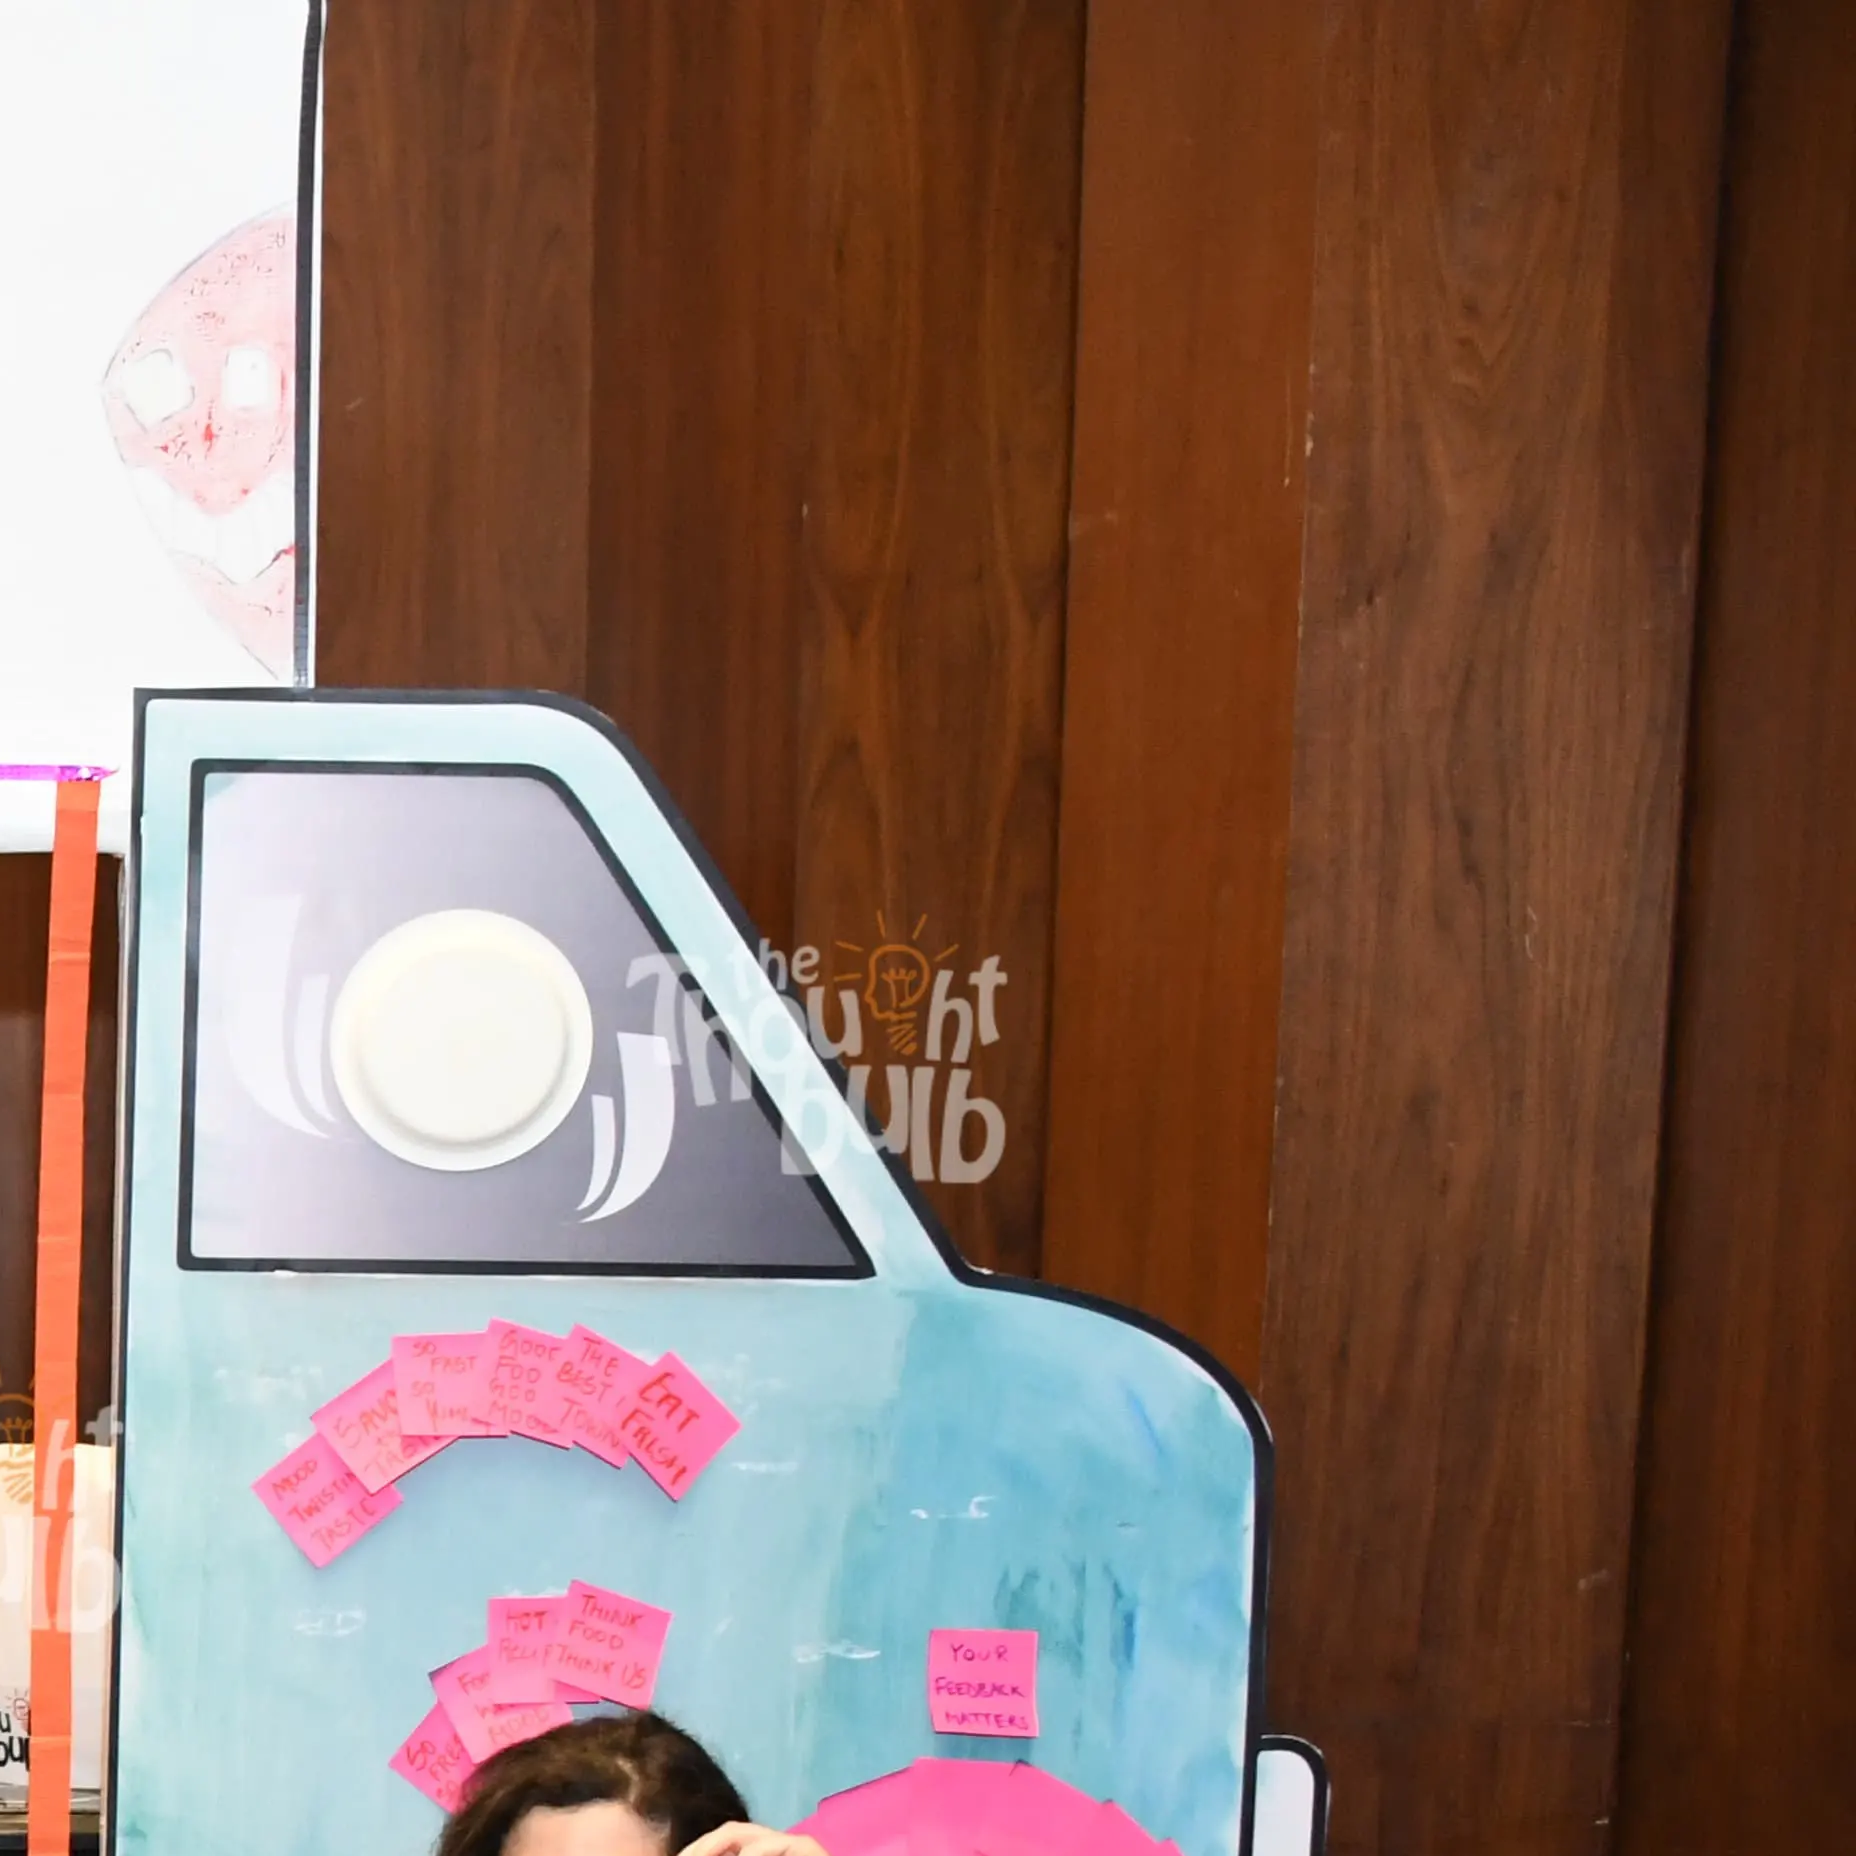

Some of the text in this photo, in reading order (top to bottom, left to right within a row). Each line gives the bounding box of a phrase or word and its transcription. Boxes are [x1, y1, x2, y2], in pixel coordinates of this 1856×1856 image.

[580, 1336, 620, 1377] THE
[638, 1372, 700, 1433] EAT
[333, 1389, 398, 1449] SAVO
[581, 1594, 644, 1628] THINK
[568, 1620, 624, 1651] FOOD
[556, 1644, 615, 1675] THINK
[950, 1643, 1008, 1662] YOUR
[935, 1676, 1026, 1698] FEEDBACK
[945, 1711, 1029, 1730] MATTERS
